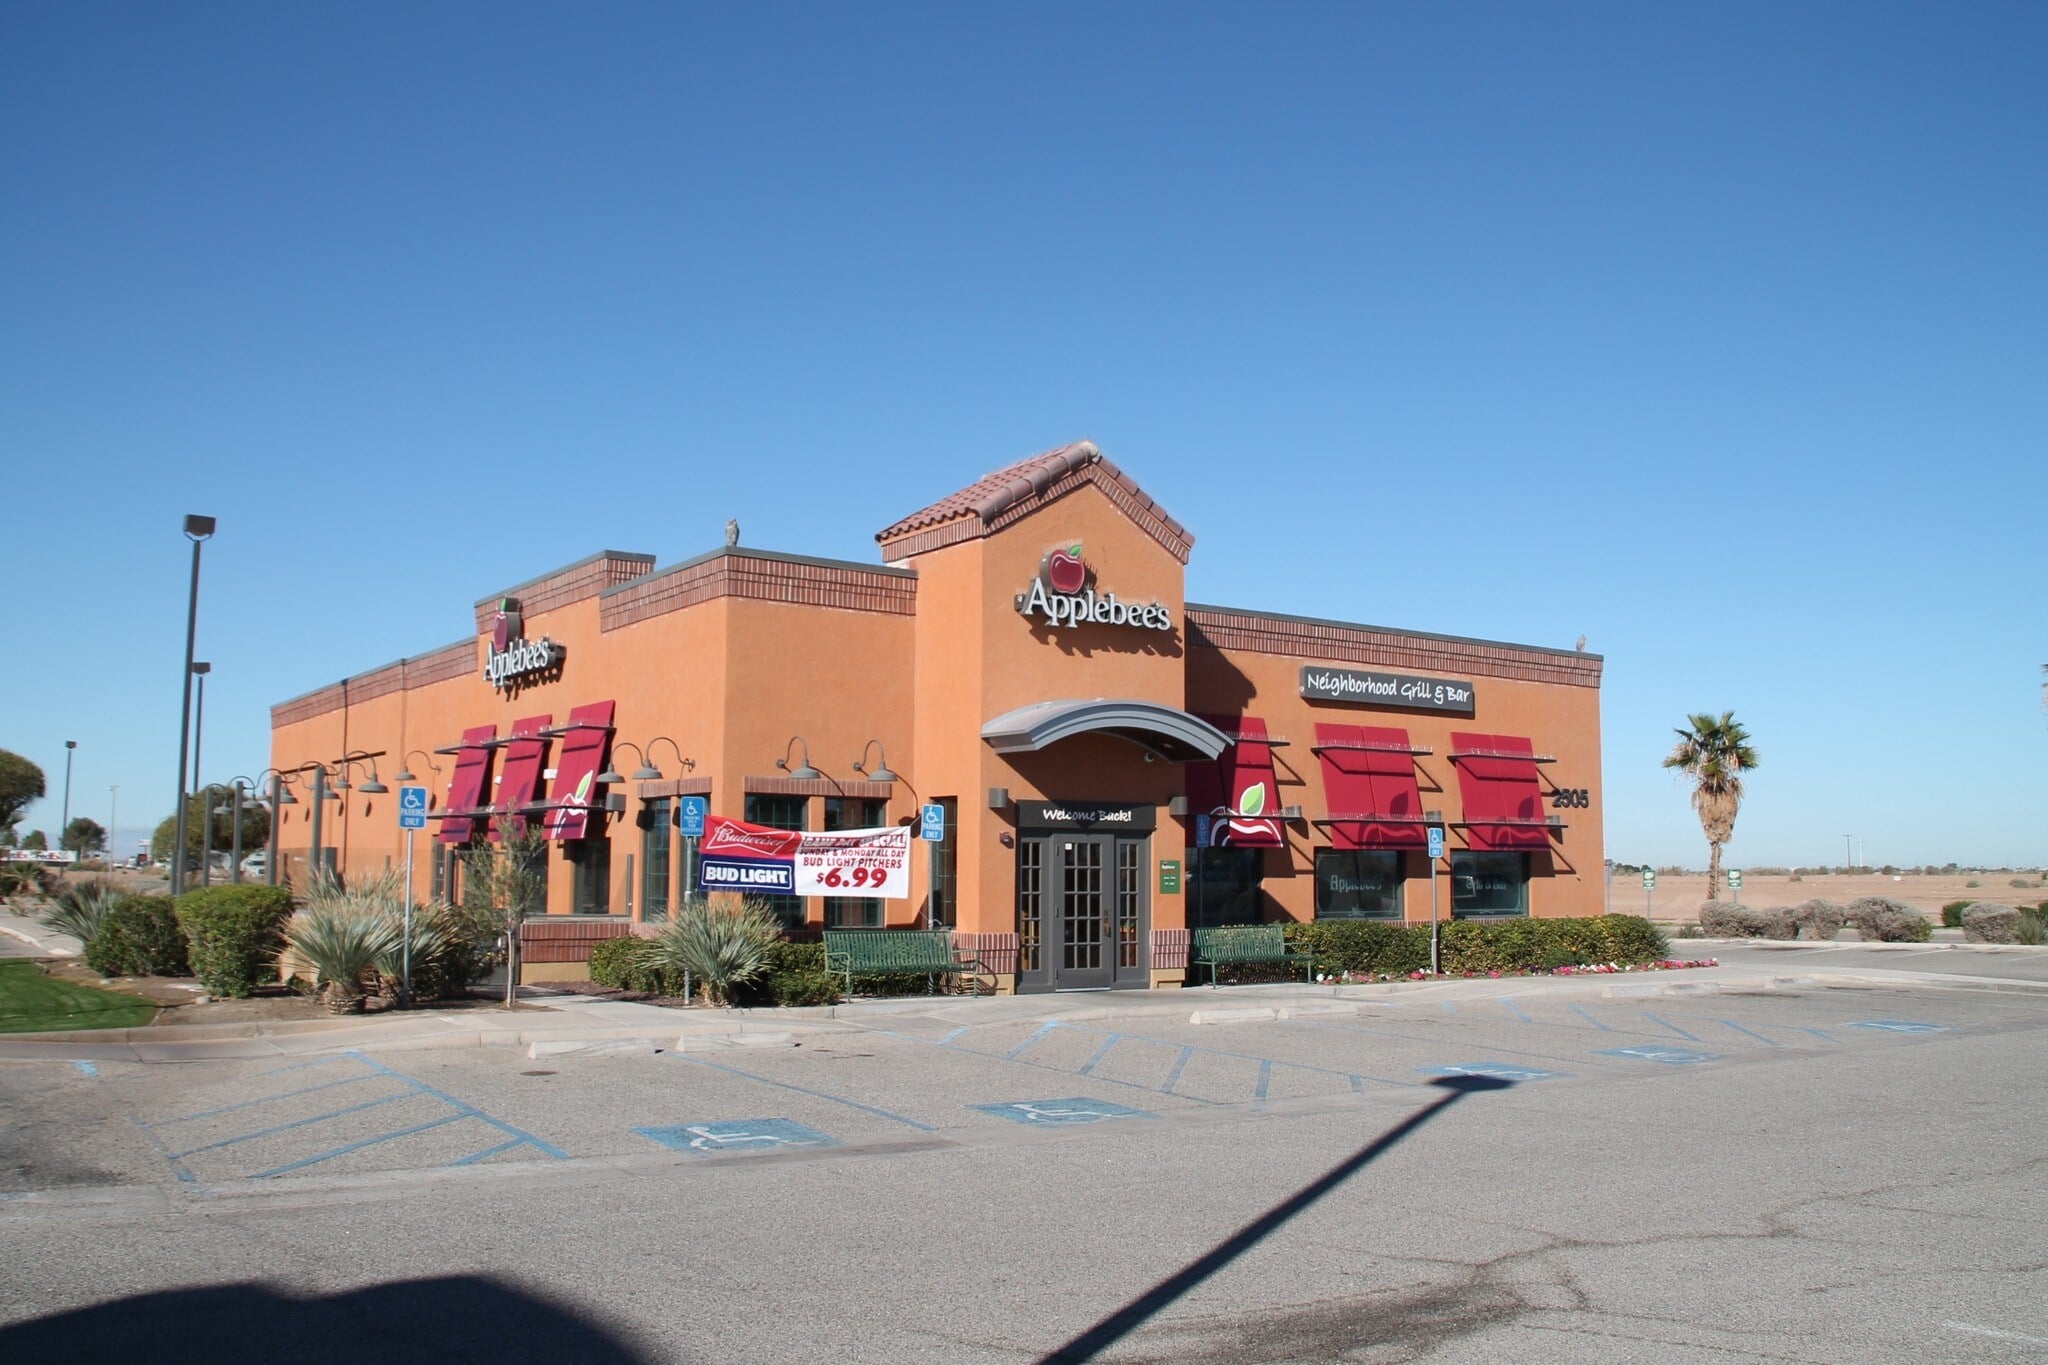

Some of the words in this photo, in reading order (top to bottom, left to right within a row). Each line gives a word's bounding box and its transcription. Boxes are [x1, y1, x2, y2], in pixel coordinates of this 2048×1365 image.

[1025, 577, 1171, 631] Applebee's
[1307, 672, 1397, 696] Neighborhood
[1401, 680, 1432, 700] Grill
[1434, 685, 1444, 705] &
[1447, 687, 1471, 702] Bar
[1552, 788, 1589, 808] 2505
[1043, 808, 1096, 821] Welcome
[1097, 810, 1132, 822] Back!
[715, 826, 788, 847] Budweiser
[803, 857, 823, 867] BUD
[827, 858, 857, 868] LIGHT
[857, 858, 902, 869] PITCHERS
[891, 850, 906, 858] DAY
[705, 866, 739, 882] BUD
[740, 868, 788, 885] LIGHT
[816, 867, 888, 888] $6.99
